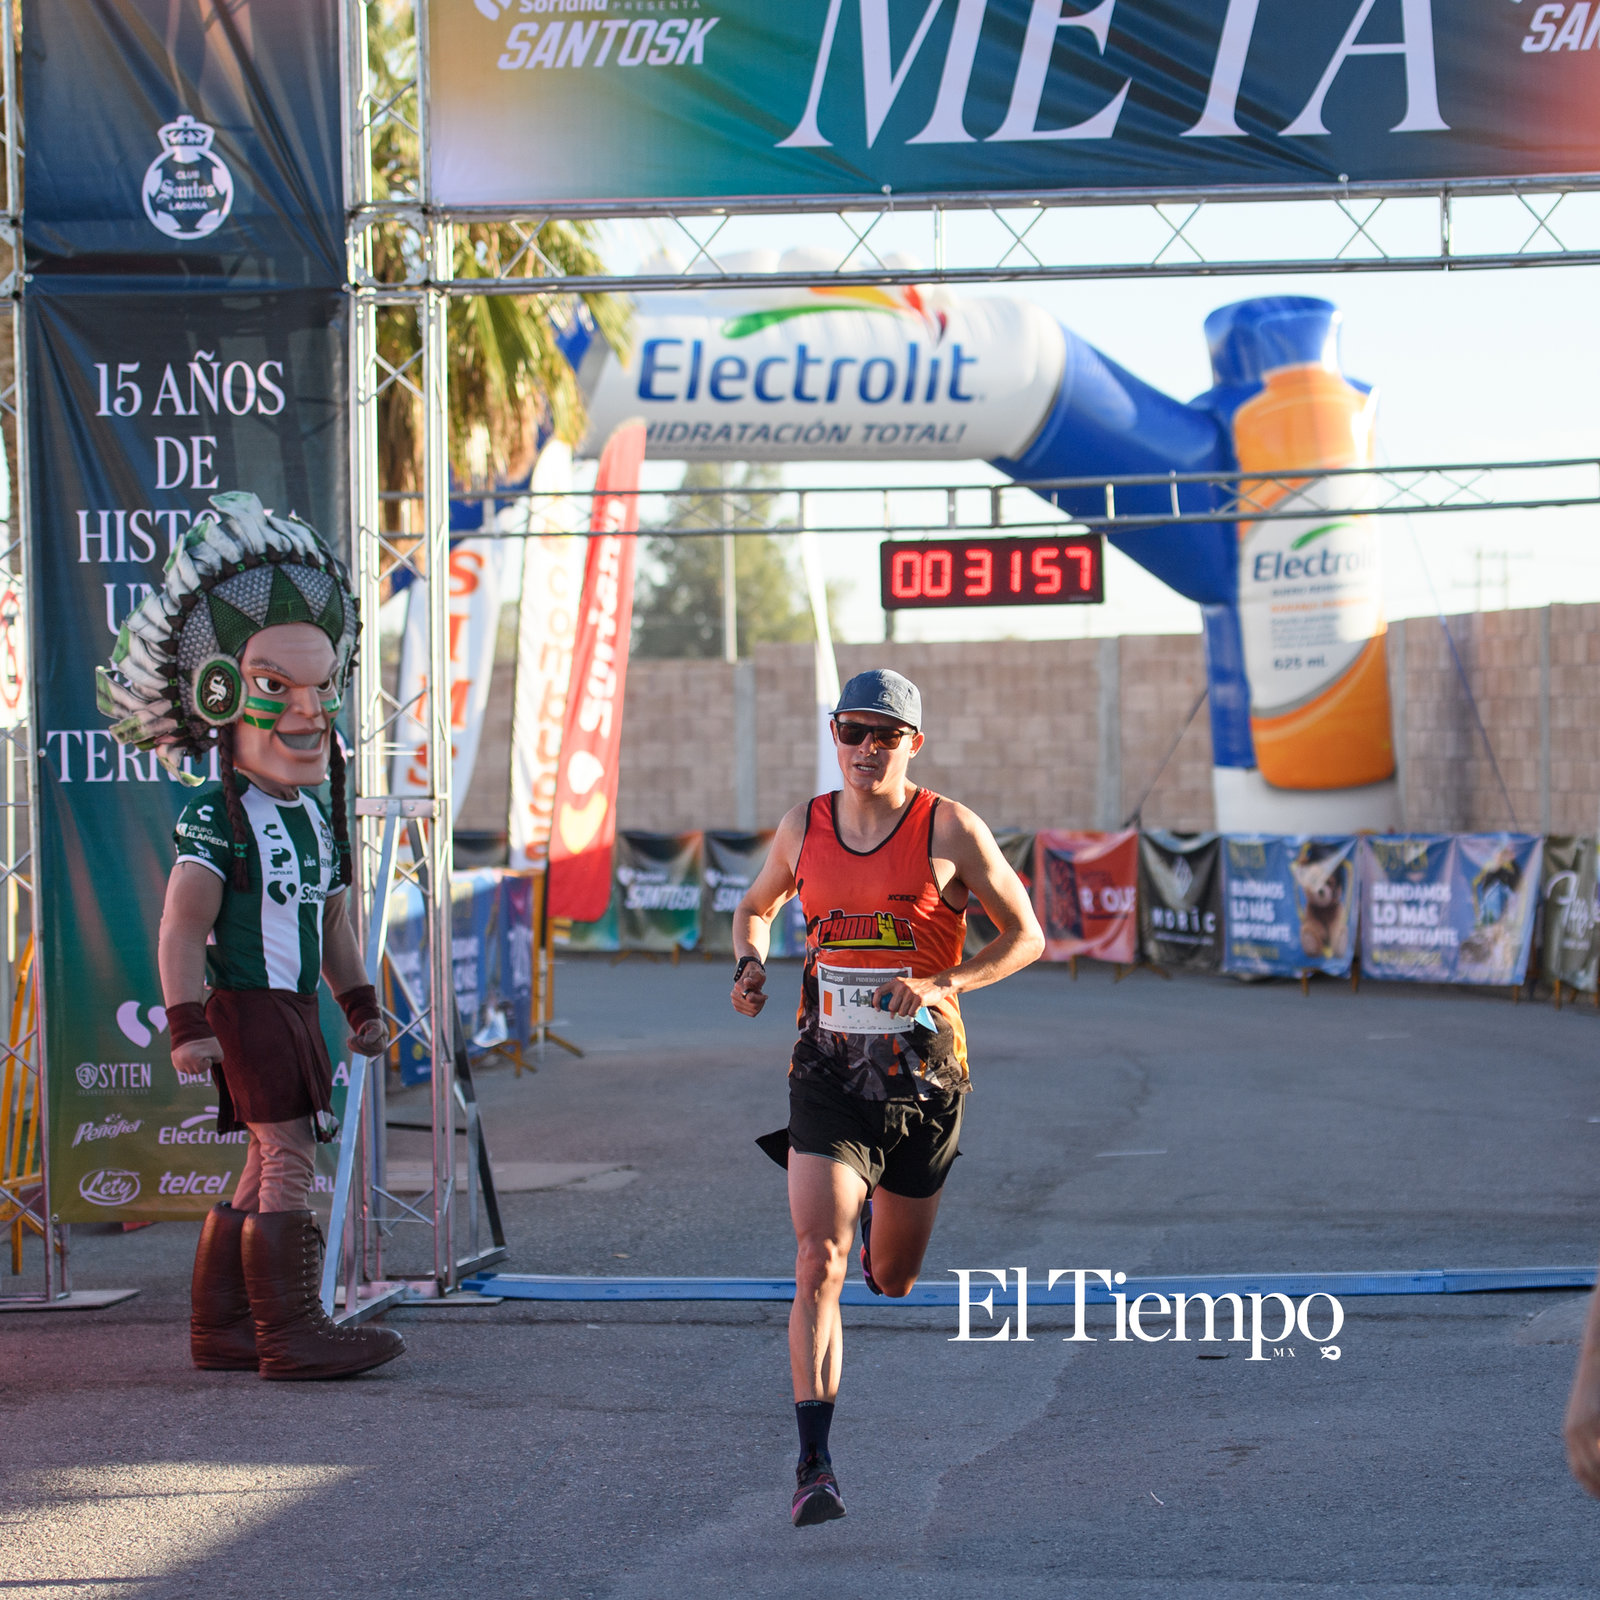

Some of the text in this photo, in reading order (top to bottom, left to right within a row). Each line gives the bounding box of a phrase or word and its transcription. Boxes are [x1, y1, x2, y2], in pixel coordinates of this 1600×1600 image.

[497, 17, 721, 70] SANTOSK
[175, 170, 200, 180] CLUB
[156, 179, 216, 204] Santos
[168, 201, 208, 211] LAGUNA
[94, 350, 285, 417] 15 AÑOS
[637, 338, 979, 404] Electrolit
[861, 422, 967, 444] TOTAL!
[155, 436, 219, 489] DE
[1253, 549, 1378, 582] Electroli
[186, 831, 229, 849] ALAMEDA
[188, 825, 214, 836] GRUPO
[1373, 903, 1397, 925] LO
[98, 1063, 151, 1088] SYTEN
[83, 1171, 134, 1200] Lety
[158, 1171, 232, 1195] telcel
